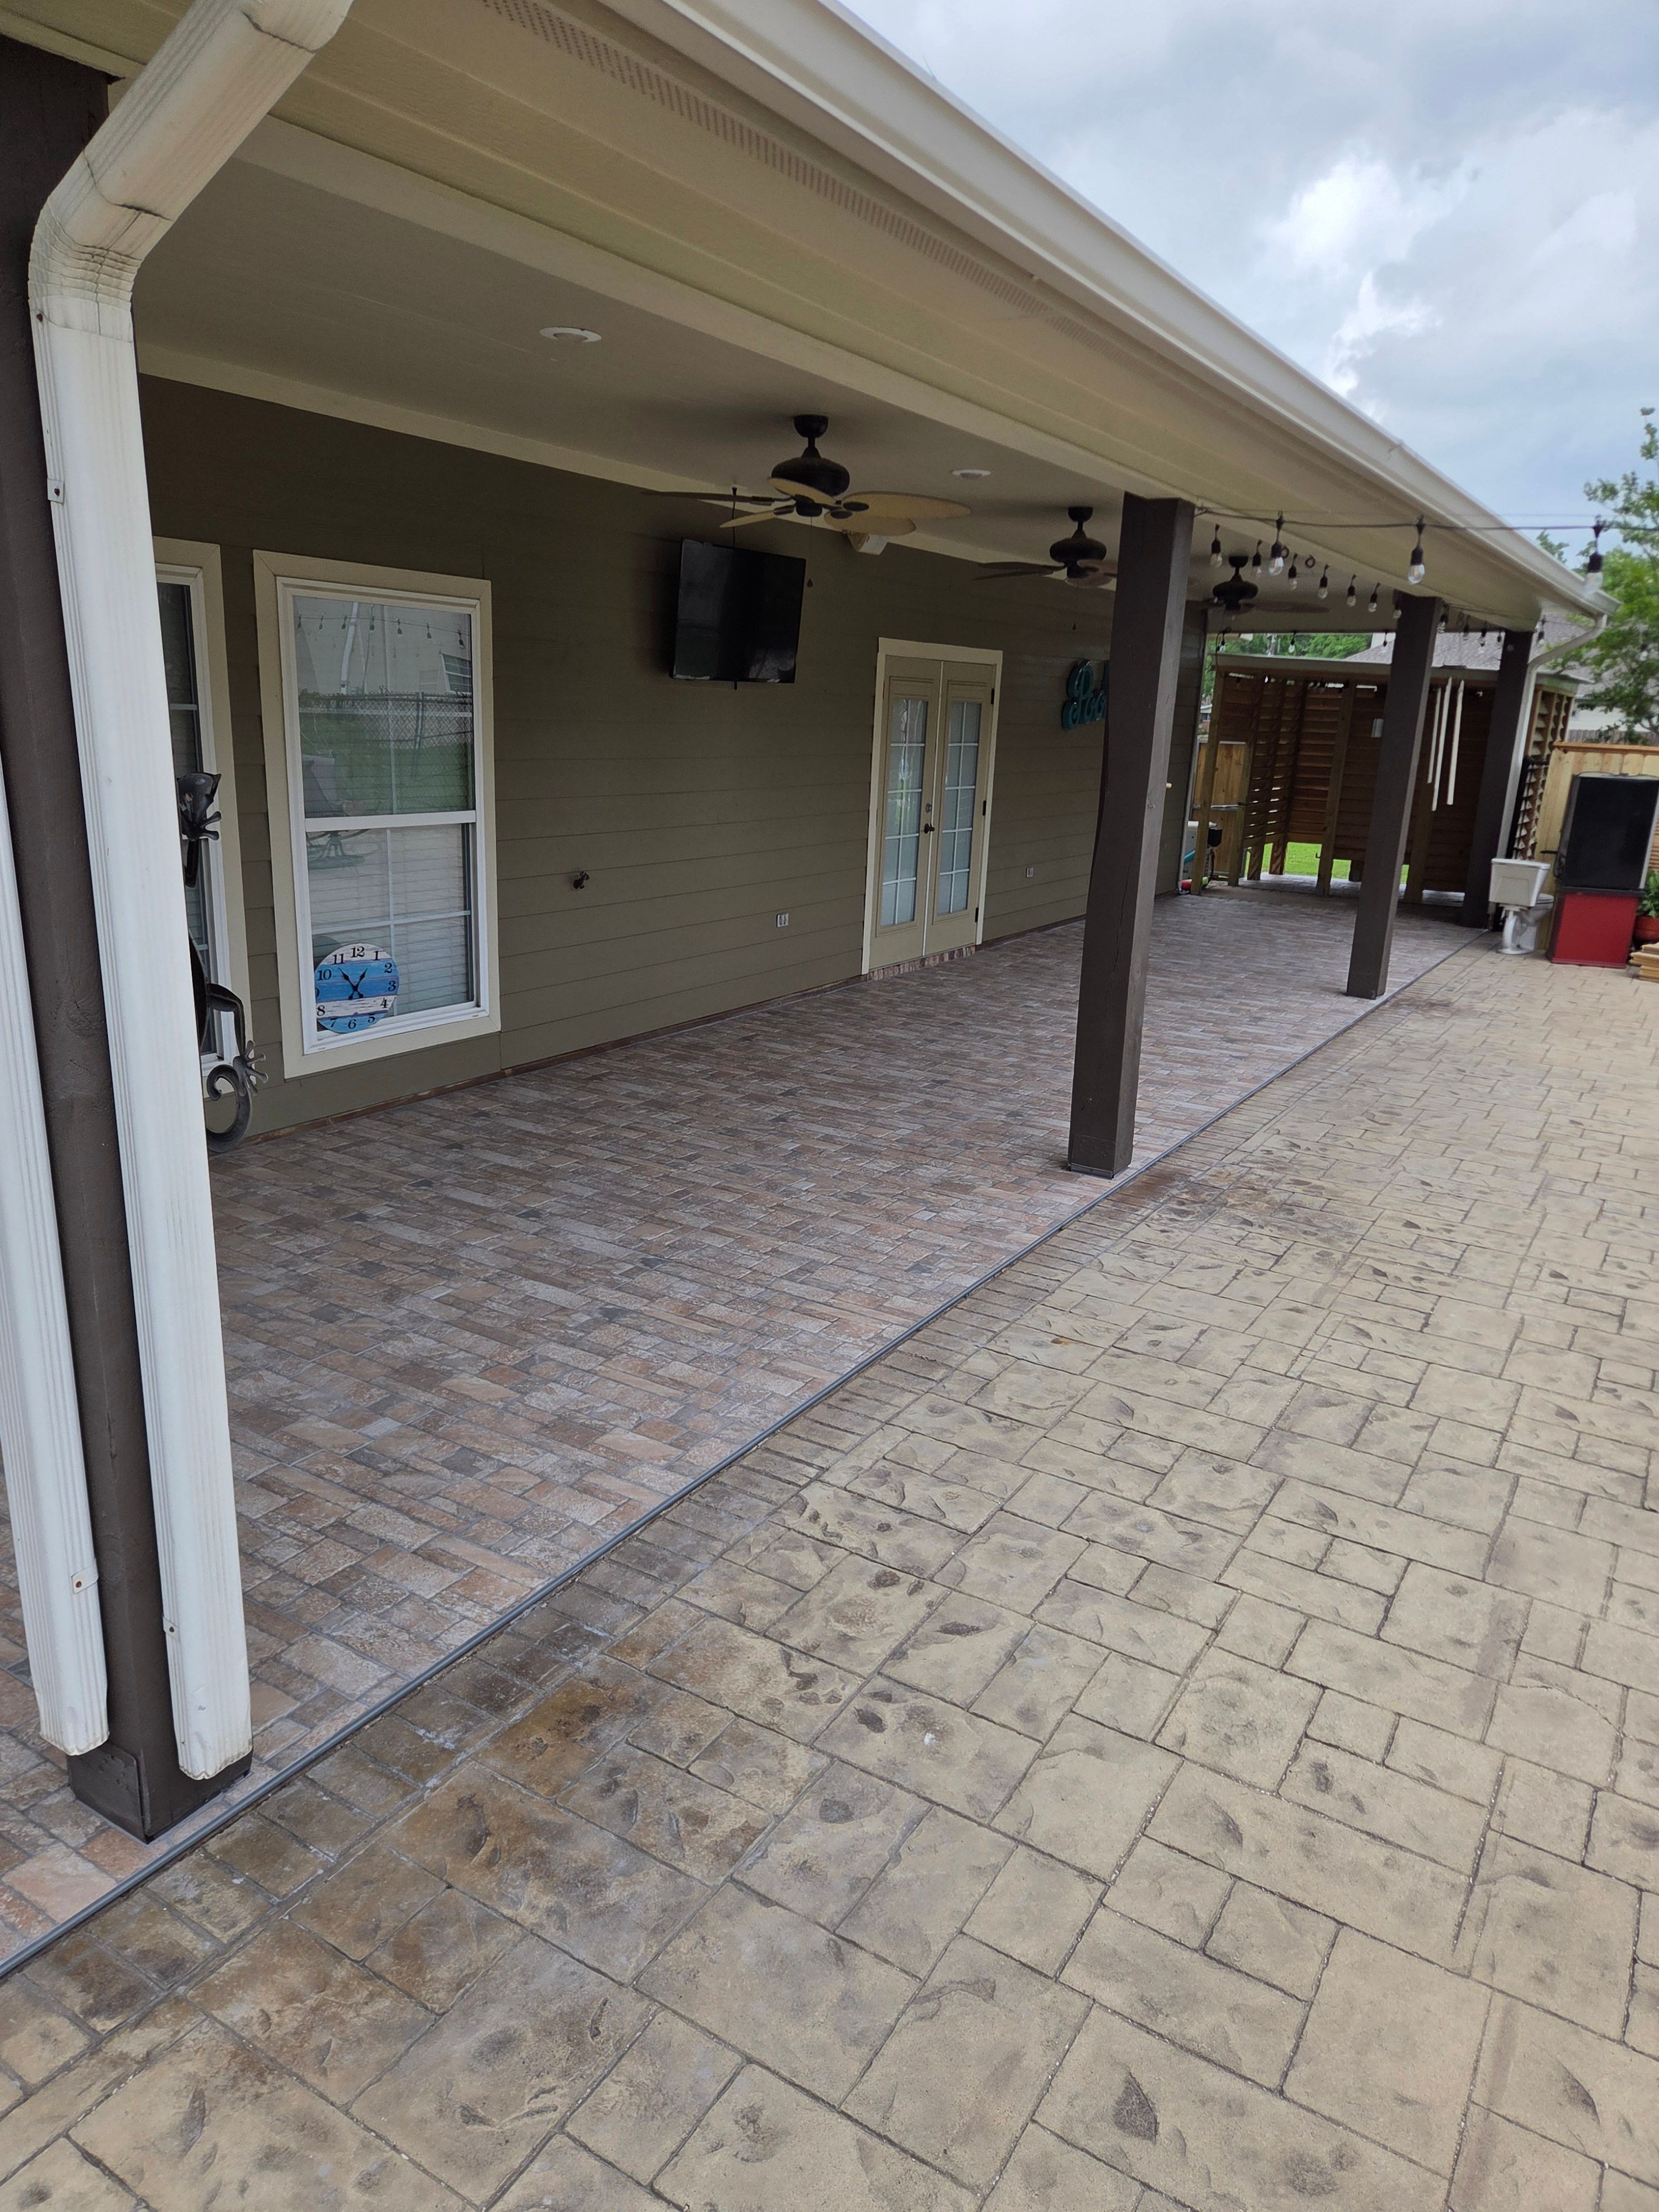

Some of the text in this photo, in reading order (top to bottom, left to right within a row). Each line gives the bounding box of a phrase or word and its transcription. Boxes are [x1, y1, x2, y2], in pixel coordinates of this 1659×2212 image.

[351, 946, 365, 958] 12
[373, 951, 380, 961] 1
[332, 953, 345, 964] 11
[384, 963, 393, 973] 2
[317, 969, 332, 980] 10
[388, 980, 397, 992] 3
[380, 998, 389, 1009] 4
[317, 1005, 325, 1016] 8
[330, 1018, 338, 1027] 7
[367, 1013, 375, 1023] 5
[348, 1019, 357, 1029] 6
